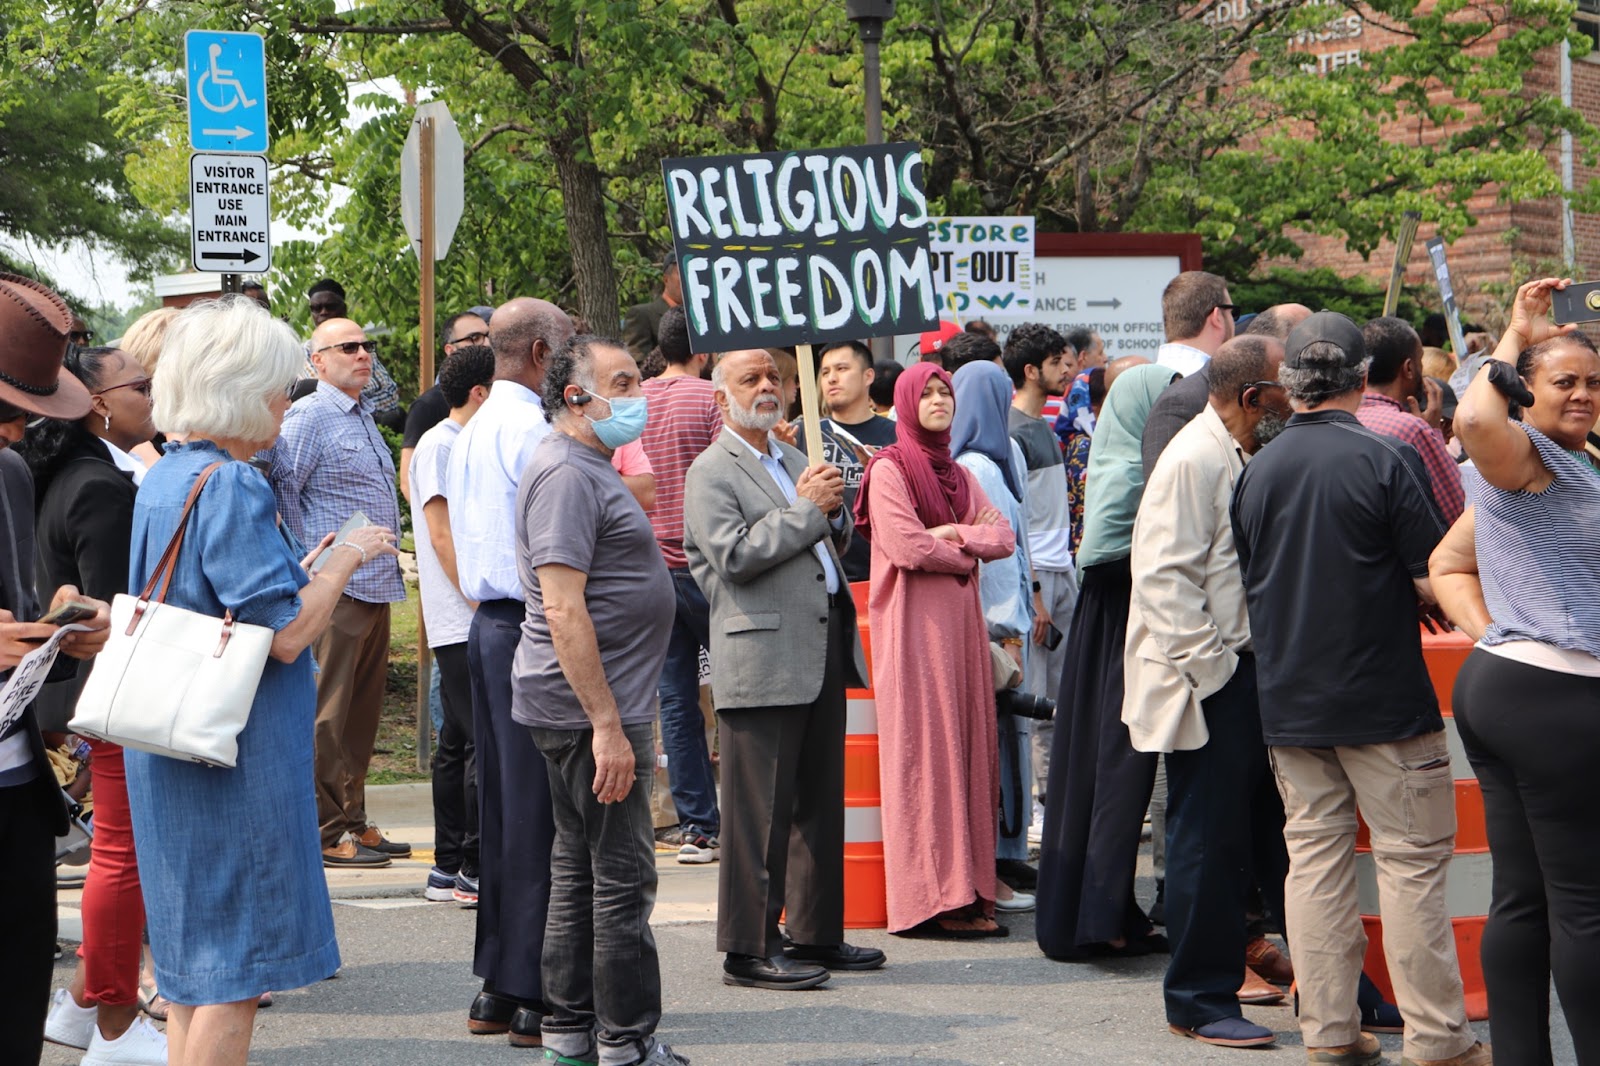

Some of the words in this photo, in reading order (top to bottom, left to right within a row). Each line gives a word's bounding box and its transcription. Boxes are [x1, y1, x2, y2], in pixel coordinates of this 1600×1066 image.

[204, 166, 255, 178] VISITOR
[196, 182, 264, 195] ENTRANCE
[667, 152, 927, 239] RELIGIOUS
[218, 199, 243, 210] USE
[215, 214, 247, 226] MAIN
[198, 230, 265, 243] ENTRANCE
[971, 250, 1018, 282] OUT
[682, 246, 937, 337] FREEDOM
[1034, 297, 1077, 311] ANCE
